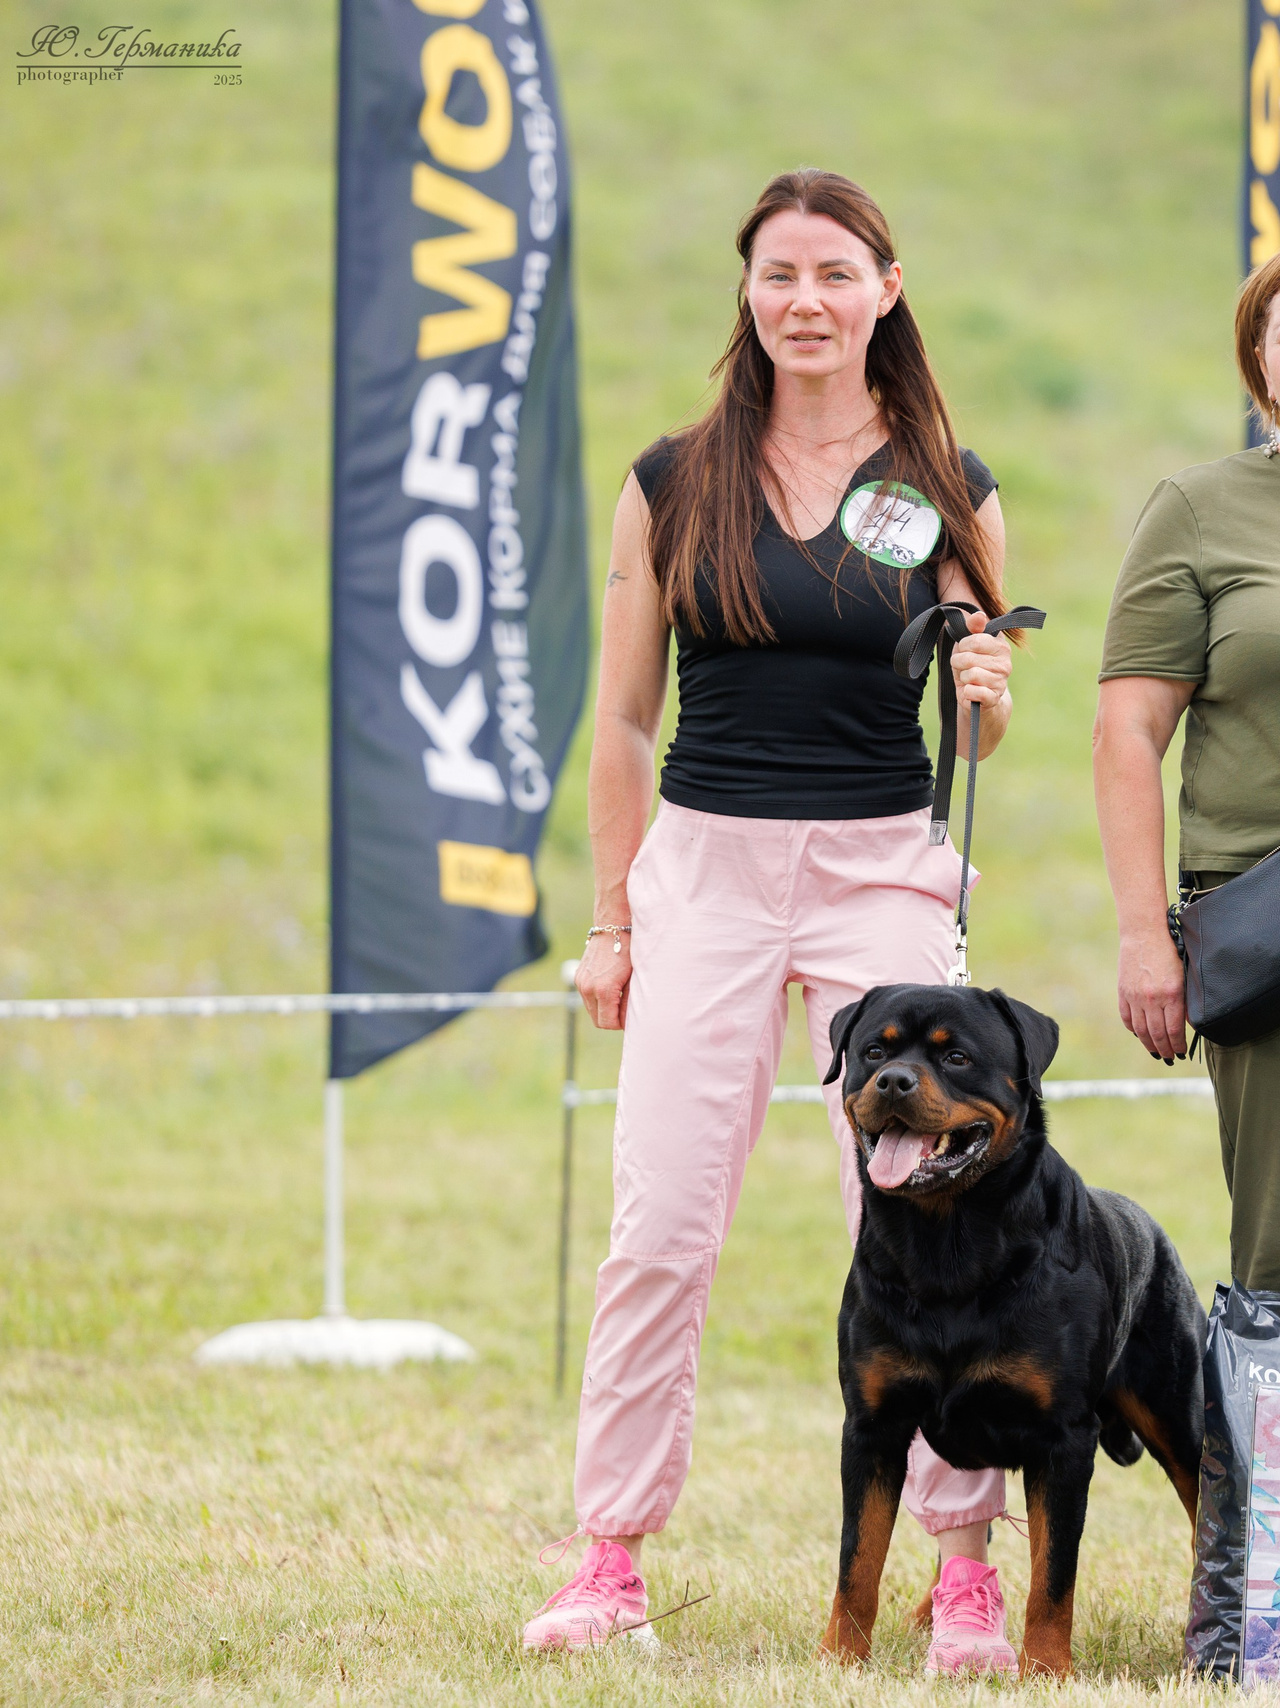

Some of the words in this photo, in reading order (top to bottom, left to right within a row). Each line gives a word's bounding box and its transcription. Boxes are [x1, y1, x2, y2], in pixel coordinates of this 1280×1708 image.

[398, 0, 518, 806] KORWO
[488, 391, 529, 611] КОРМА
[490, 619, 552, 813] СУХИЕ
